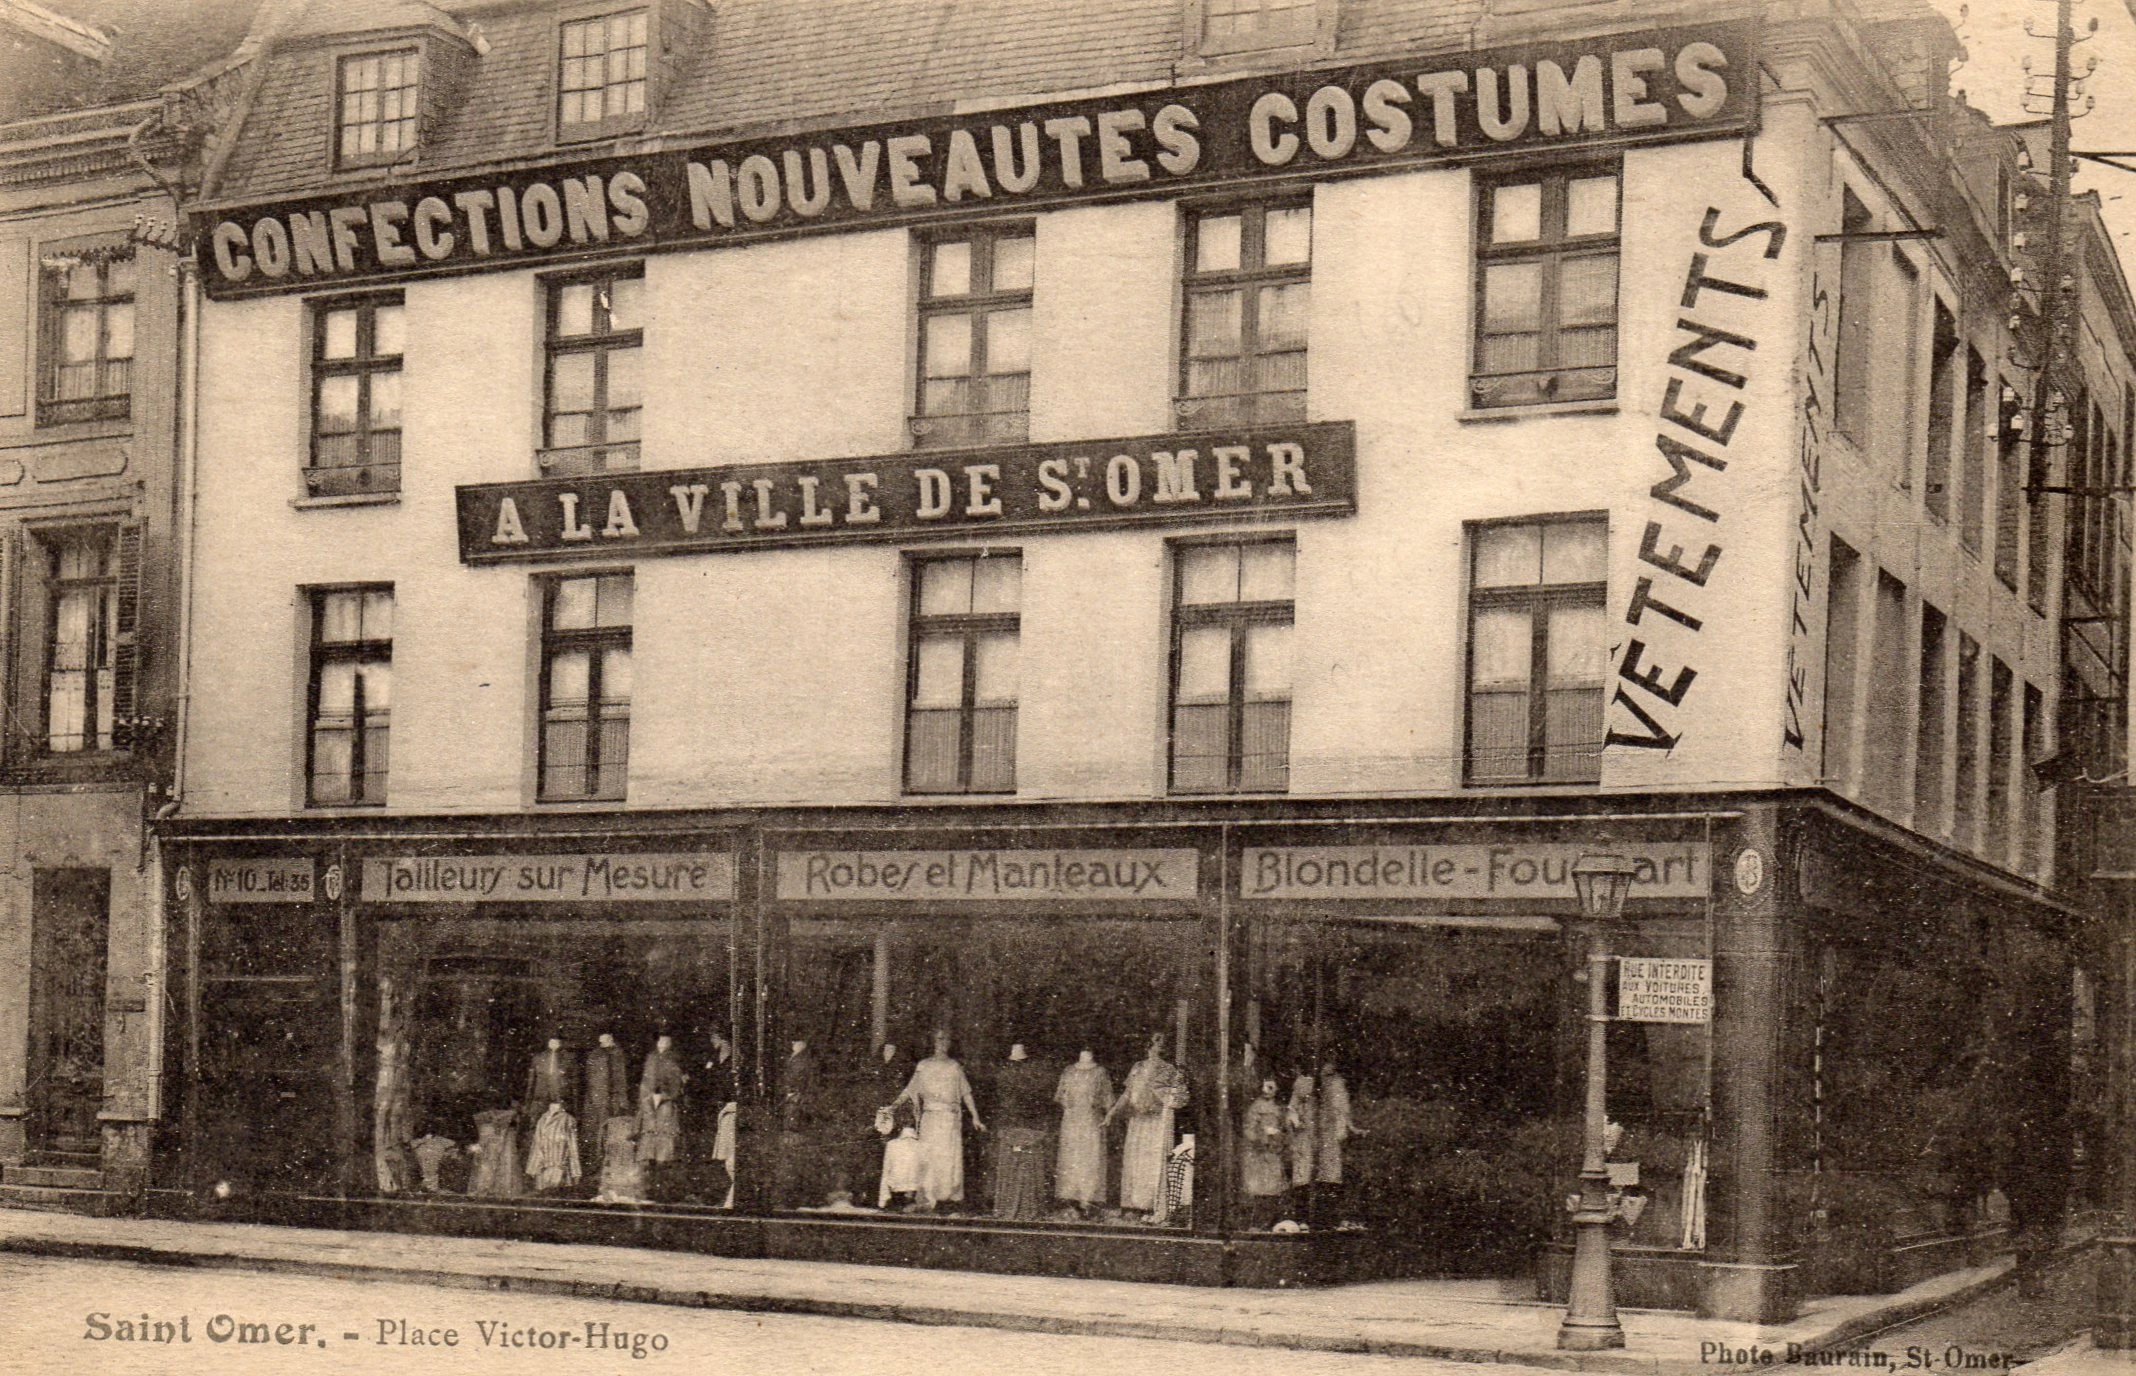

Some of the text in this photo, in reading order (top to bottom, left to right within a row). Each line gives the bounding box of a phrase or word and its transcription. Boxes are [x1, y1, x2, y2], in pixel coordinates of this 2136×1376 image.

[213, 42, 1728, 281] CONFECTIONS NOUVEAUTES COSTUMES
[492, 497, 529, 543] A
[559, 490, 640, 541] LA
[670, 472, 881, 532] VILLE
[916, 463, 1001, 520] DE
[376, 858, 505, 897] Tailleurs
[517, 864, 573, 891] sur
[582, 856, 707, 897] Mesure
[805, 853, 1168, 895] Robes et Manteaux
[1622, 980, 1640, 992] AUX
[1623, 961, 1706, 981] RUE INTERDITE
[1632, 993, 1709, 1007] AUTOMOBILES
[1633, 1005, 1666, 1018] CYCLES
